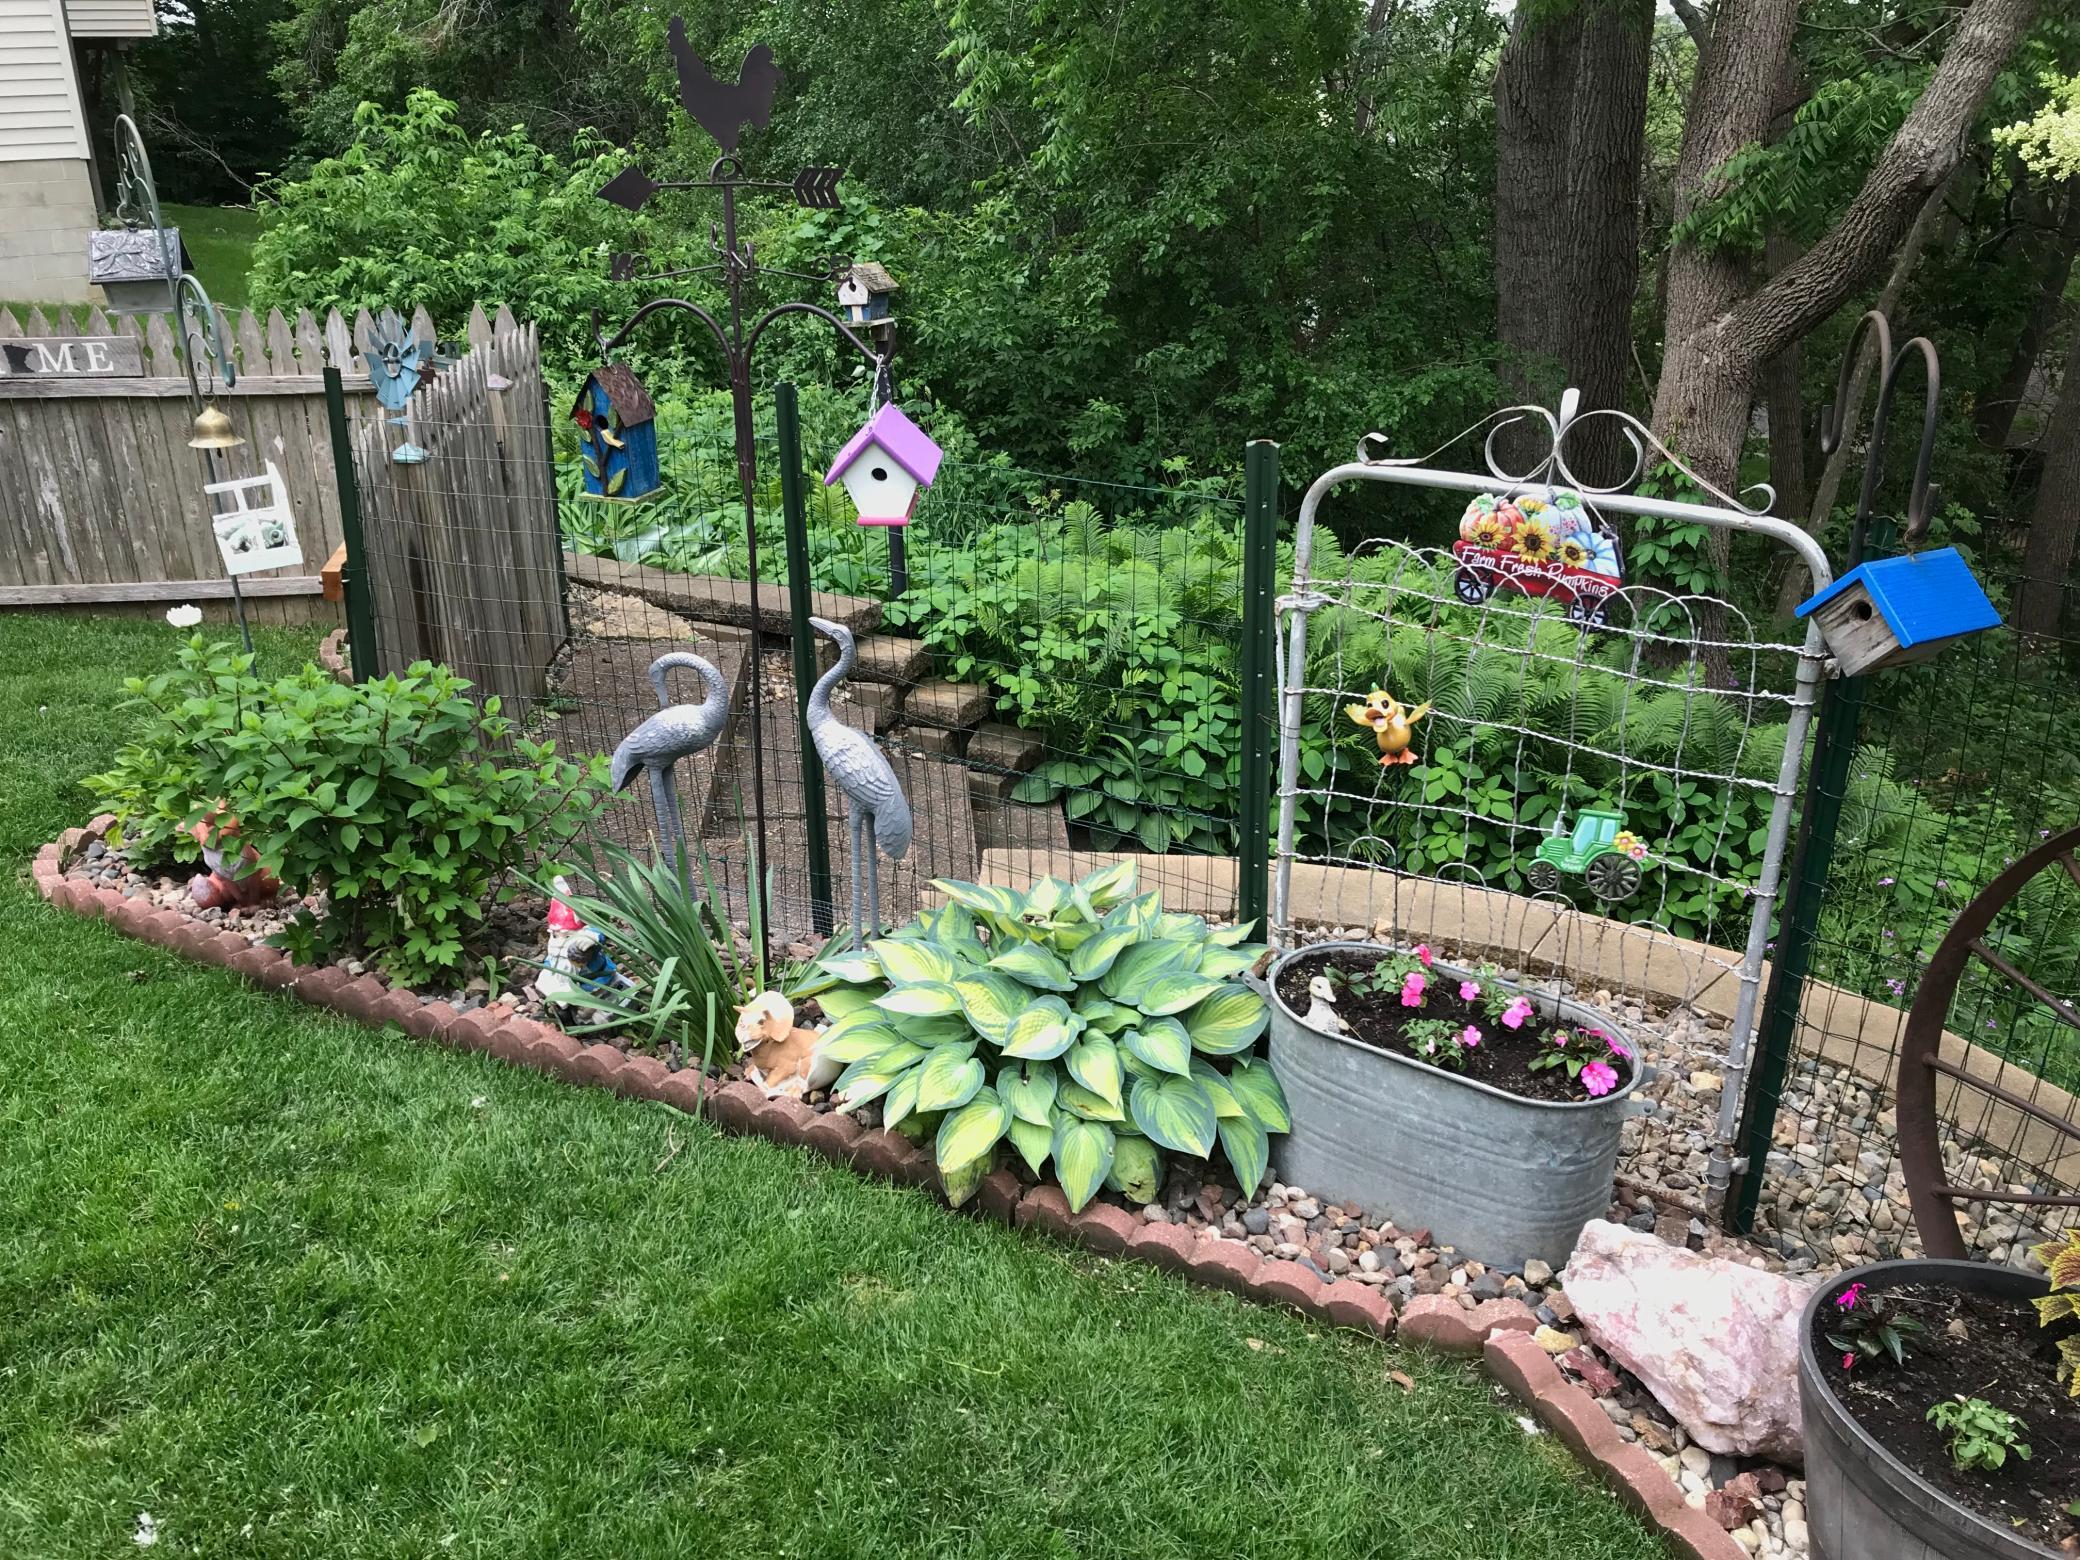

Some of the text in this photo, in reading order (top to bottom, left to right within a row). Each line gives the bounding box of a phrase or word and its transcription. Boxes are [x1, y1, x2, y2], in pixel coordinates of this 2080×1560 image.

[1461, 546, 1610, 597] Farm Fresh Pumpkins
